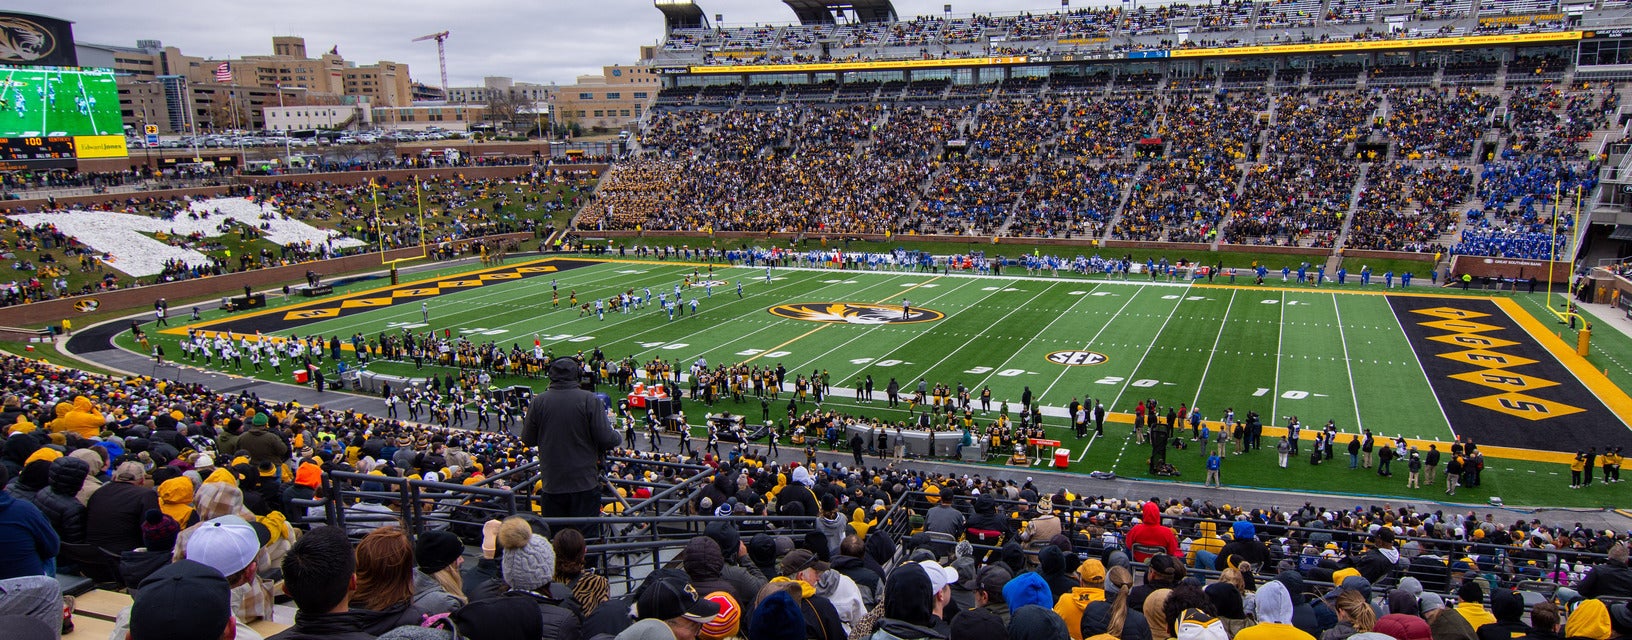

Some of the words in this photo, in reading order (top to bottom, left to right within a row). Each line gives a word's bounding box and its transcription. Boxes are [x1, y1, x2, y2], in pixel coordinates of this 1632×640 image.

[1049, 351, 1105, 365] SEC
[1094, 376, 1160, 388] 20
[1252, 387, 1309, 399] 10
[631, 396, 638, 405] G
